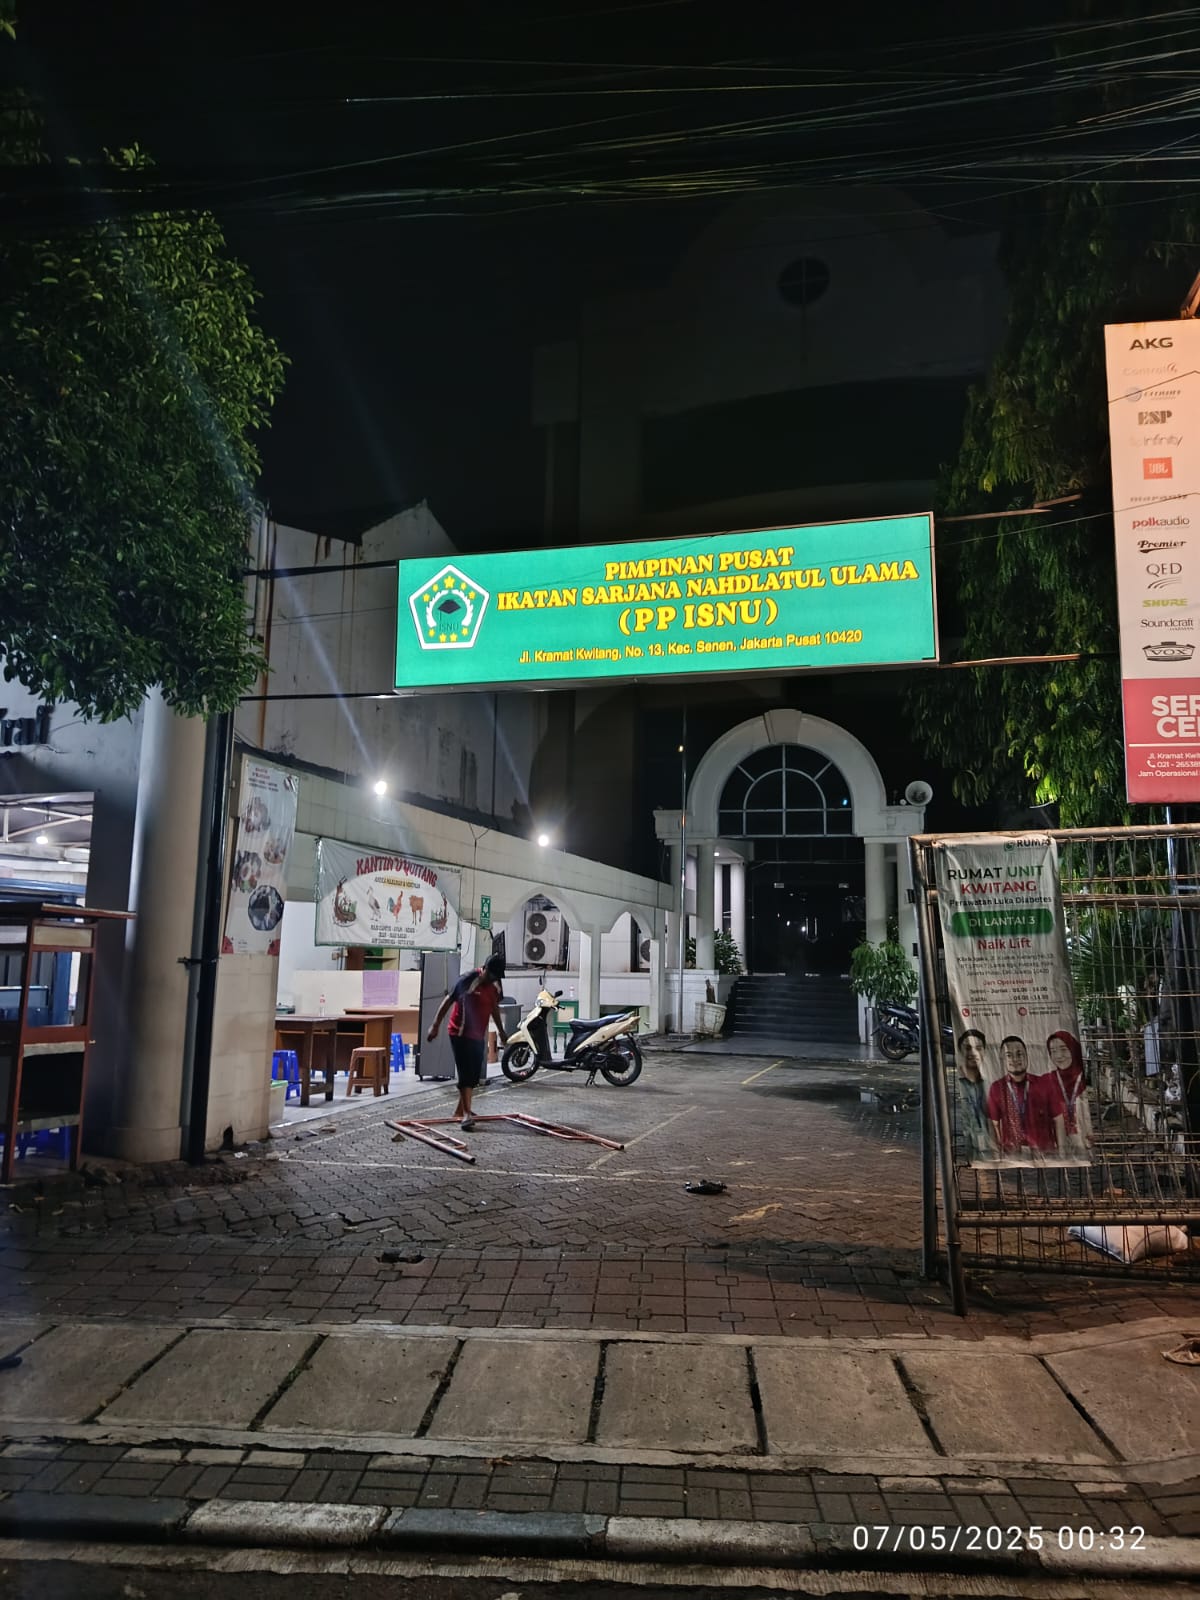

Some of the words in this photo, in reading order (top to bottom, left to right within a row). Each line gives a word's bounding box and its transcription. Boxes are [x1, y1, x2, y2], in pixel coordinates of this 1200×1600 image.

[1129, 337, 1174, 351] AKG
[1137, 410, 1173, 425] ESP
[1148, 462, 1169, 474] JBL
[1132, 516, 1190, 530] polkaudio
[1137, 540, 1187, 549] Premier
[605, 554, 714, 581] PIMPINAN
[719, 546, 794, 572] PUSAT
[1146, 562, 1183, 577] QED
[496, 586, 578, 611] IKATAN
[582, 579, 681, 606] SARJANA
[686, 568, 826, 597] NAHDLATUL
[830, 560, 919, 586] ULAMA
[1142, 598, 1188, 608] SHURE
[683, 598, 778, 629] ISNU)
[1140, 618, 1194, 628] Soundcraft
[519, 650, 531, 663] Jl.
[534, 648, 574, 663] Kramat
[576, 646, 622, 661] Kwitang,
[625, 645, 644, 657] No.
[649, 643, 665, 656] 13,
[668, 642, 693, 655] Kec.
[696, 639, 737, 653] Senen,
[740, 636, 783, 650] Jakarta
[786, 632, 821, 647] Pusat
[824, 629, 862, 644] 10420
[1152, 648, 1186, 656] VOX
[1156, 716, 1200, 738] CE
[1155, 769, 1198, 778] Operasional
[1017, 838, 1051, 848] RUMA
[356, 855, 394, 876] KANTIN
[947, 867, 1003, 881] RUMAT
[1007, 865, 1043, 878] UNIT
[961, 881, 1037, 895] KWITANG
[1015, 896, 1052, 904] Diabetes
[969, 918, 981, 927] DI
[984, 916, 1025, 927] LANTAI
[1028, 915, 1036, 925] 3
[977, 939, 1005, 950] Naik
[1009, 937, 1031, 949] Lift
